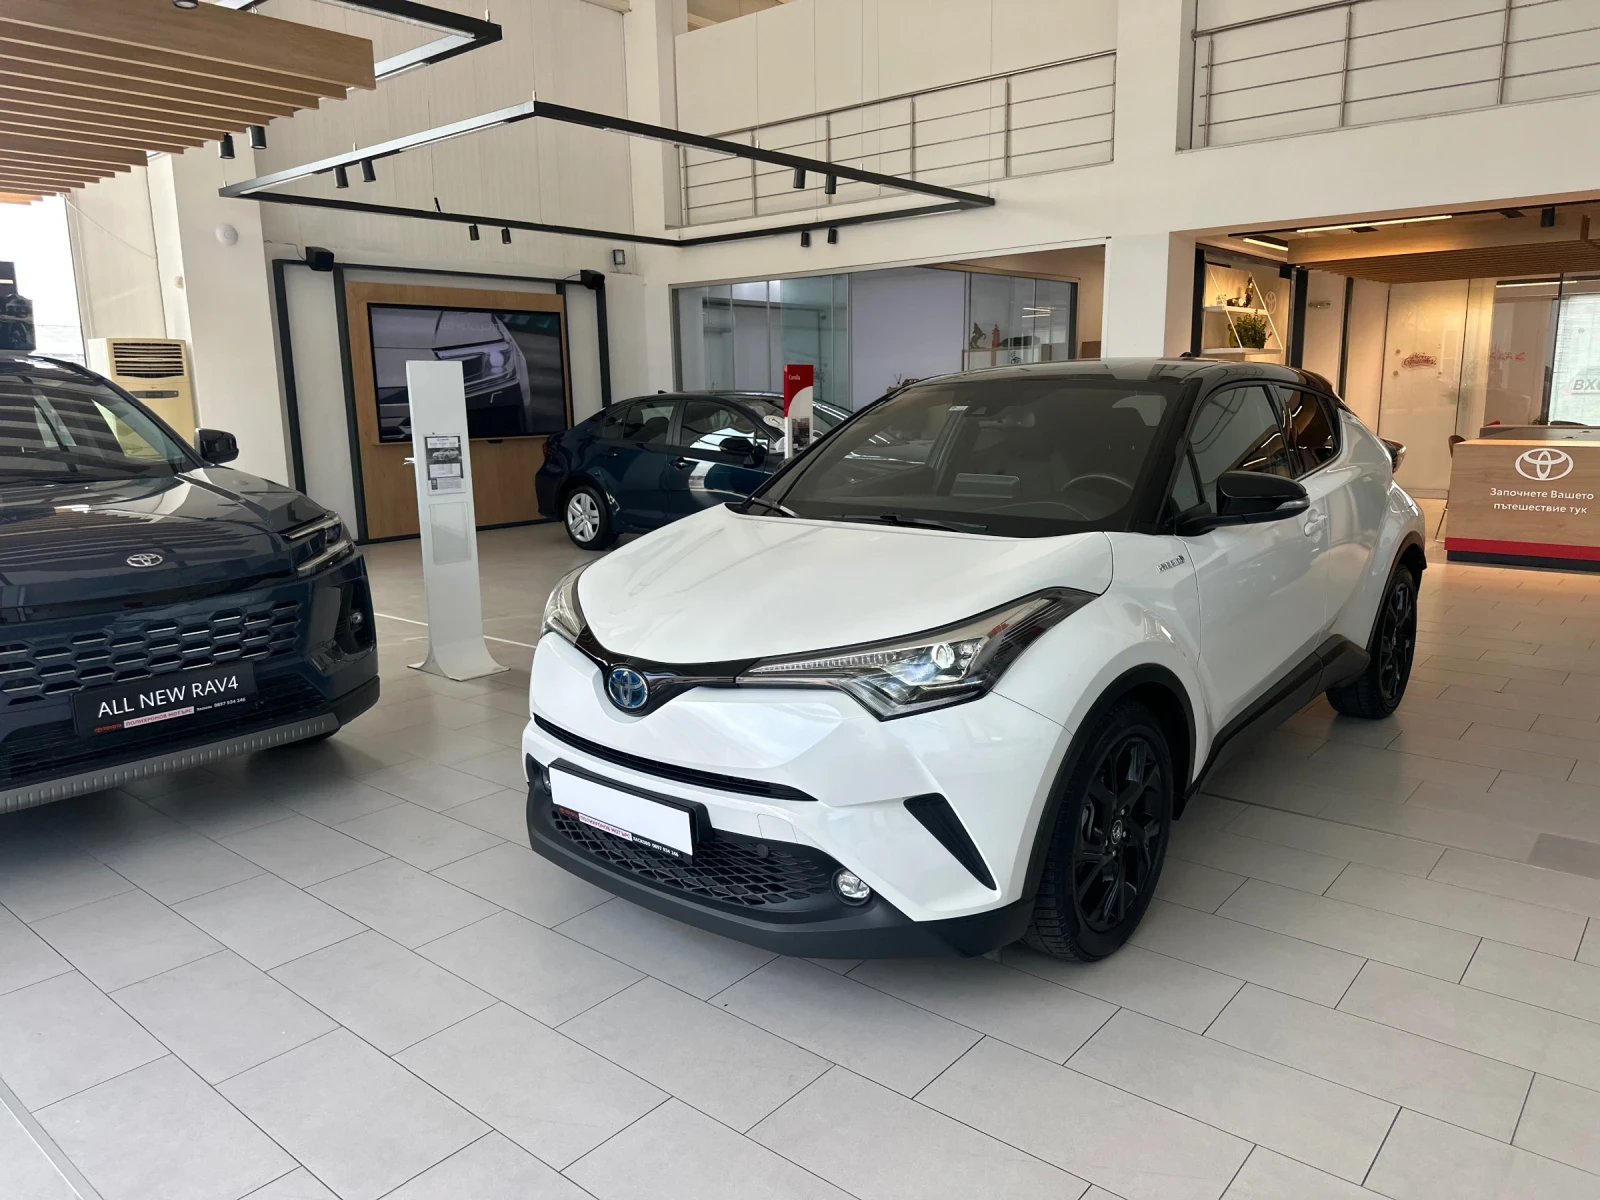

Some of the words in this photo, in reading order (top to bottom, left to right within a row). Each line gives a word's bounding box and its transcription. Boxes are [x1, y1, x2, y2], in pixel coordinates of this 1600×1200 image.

[1490, 487, 1548, 498] Започнете
[1550, 490, 1594, 500] Вашето
[1493, 503, 1567, 513] пътешествие
[1569, 506, 1588, 515] тук
[98, 697, 135, 718] ALL
[140, 685, 186, 709] NEW
[191, 675, 239, 698] RAV4
